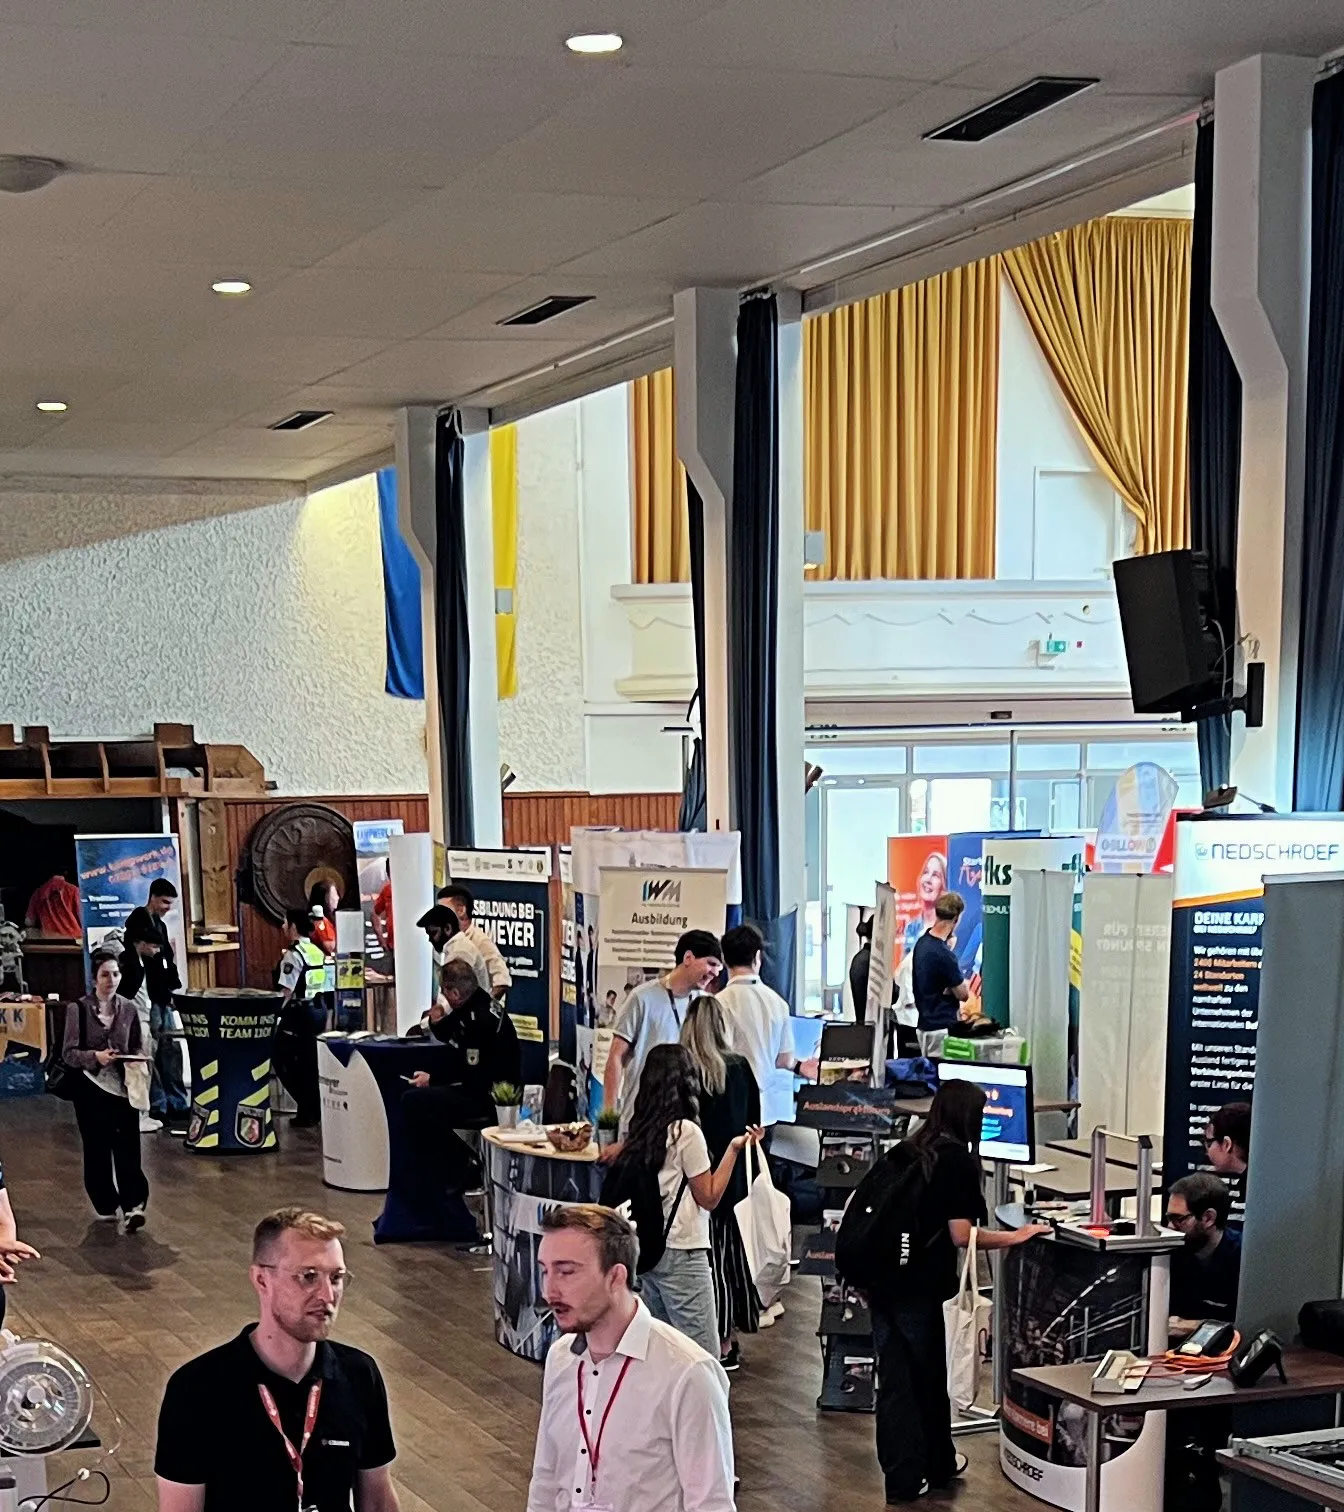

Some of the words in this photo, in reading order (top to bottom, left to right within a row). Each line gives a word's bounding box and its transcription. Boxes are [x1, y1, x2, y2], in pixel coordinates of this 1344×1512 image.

[1212, 844, 1339, 860] NEDSCHROEF
[642, 879, 682, 902] IWM
[472, 900, 517, 919] SBILDUNG
[518, 903, 534, 919] BEI
[631, 913, 688, 928] Ausbildung
[1194, 912, 1232, 925] DEINE
[472, 920, 534, 948] EMEYER
[220, 1015, 258, 1026] KOMM
[219, 1027, 252, 1039] TEAM
[900, 1232, 910, 1266] NIKE
